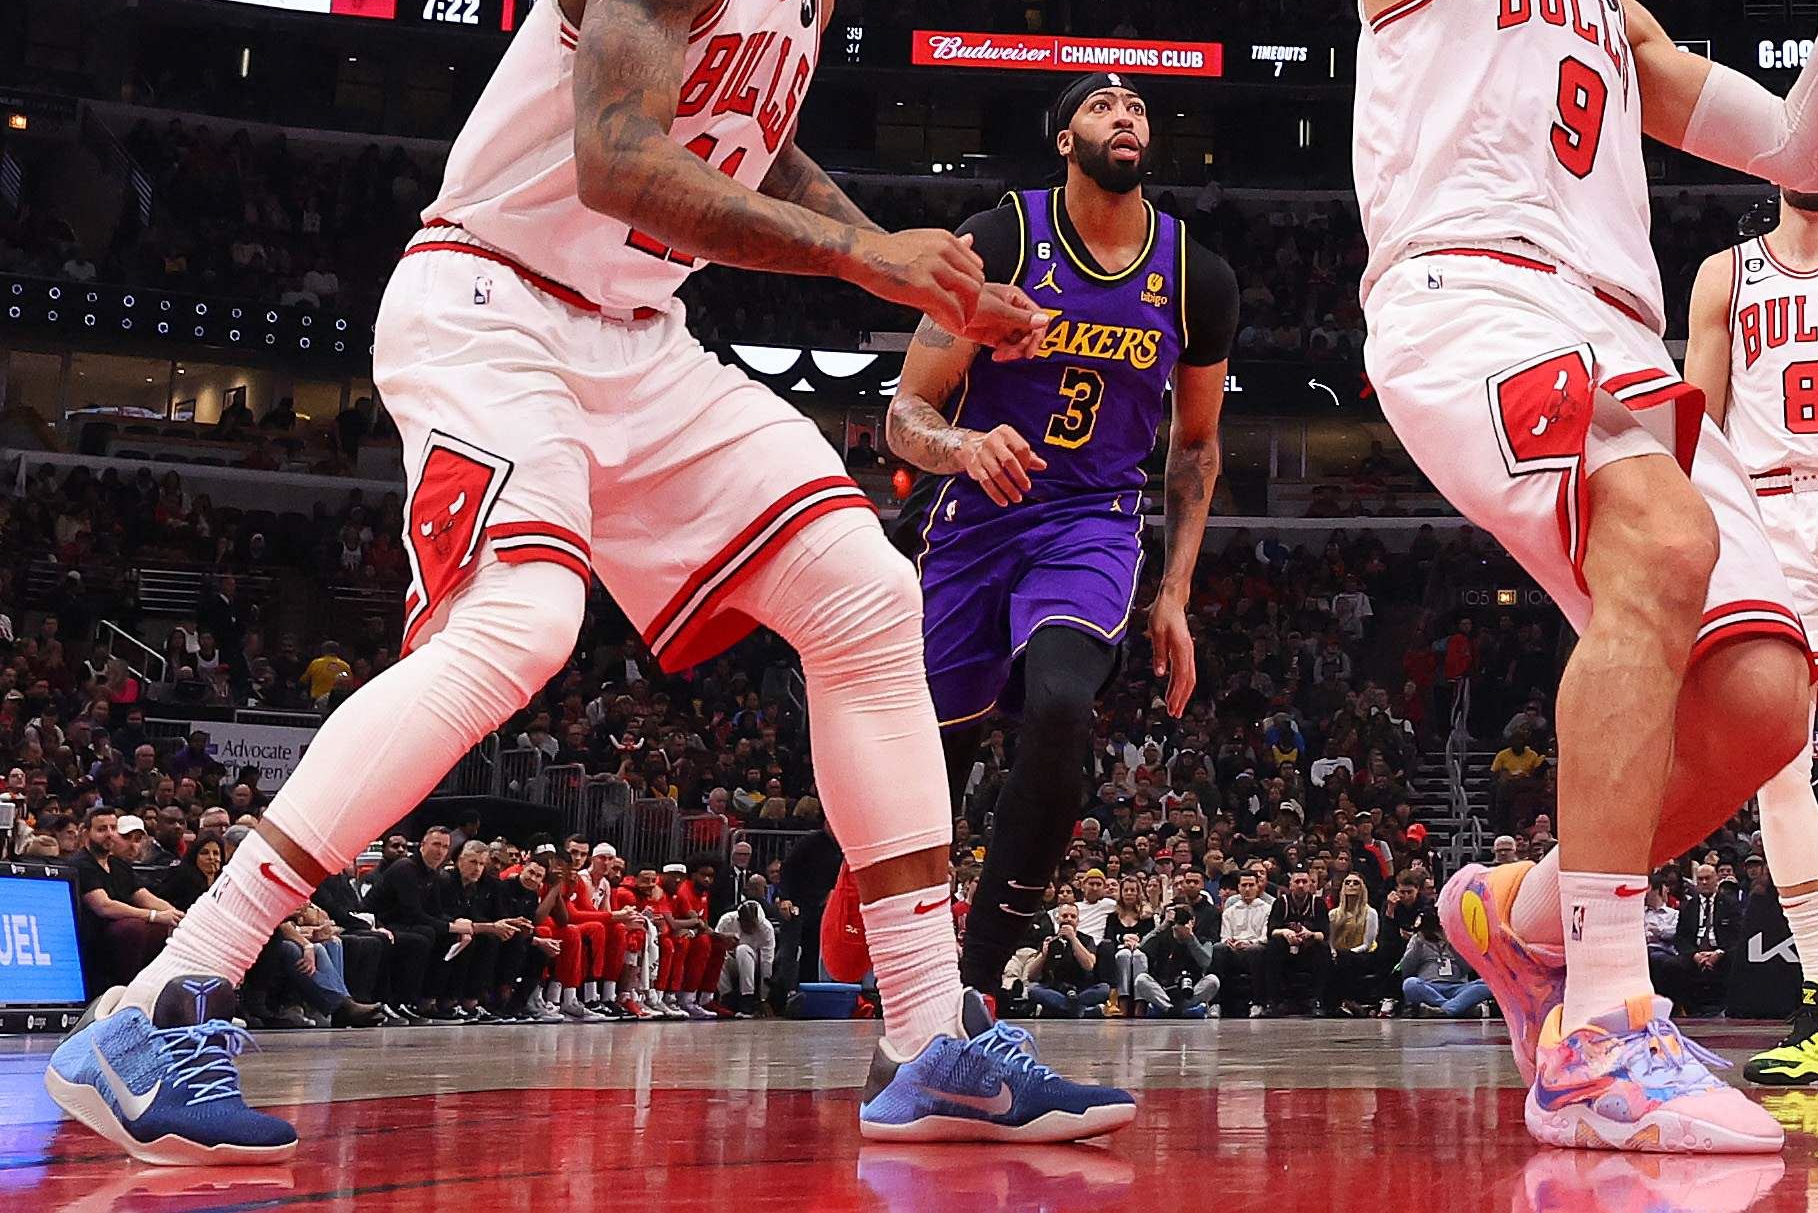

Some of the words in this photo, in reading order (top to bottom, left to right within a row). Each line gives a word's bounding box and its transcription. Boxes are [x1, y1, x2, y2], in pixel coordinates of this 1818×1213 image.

[928, 34, 1052, 63] Budweiser
[1061, 45, 1160, 67] CHAMPIONS
[1161, 50, 1204, 69] CLUB
[1251, 44, 1308, 62] TIMEOUTS
[1274, 61, 1283, 77] 7
[1549, 54, 1608, 180] 9
[1037, 242, 1051, 260] 6
[1044, 366, 1104, 450] 3
[221, 738, 292, 761] Advocate
